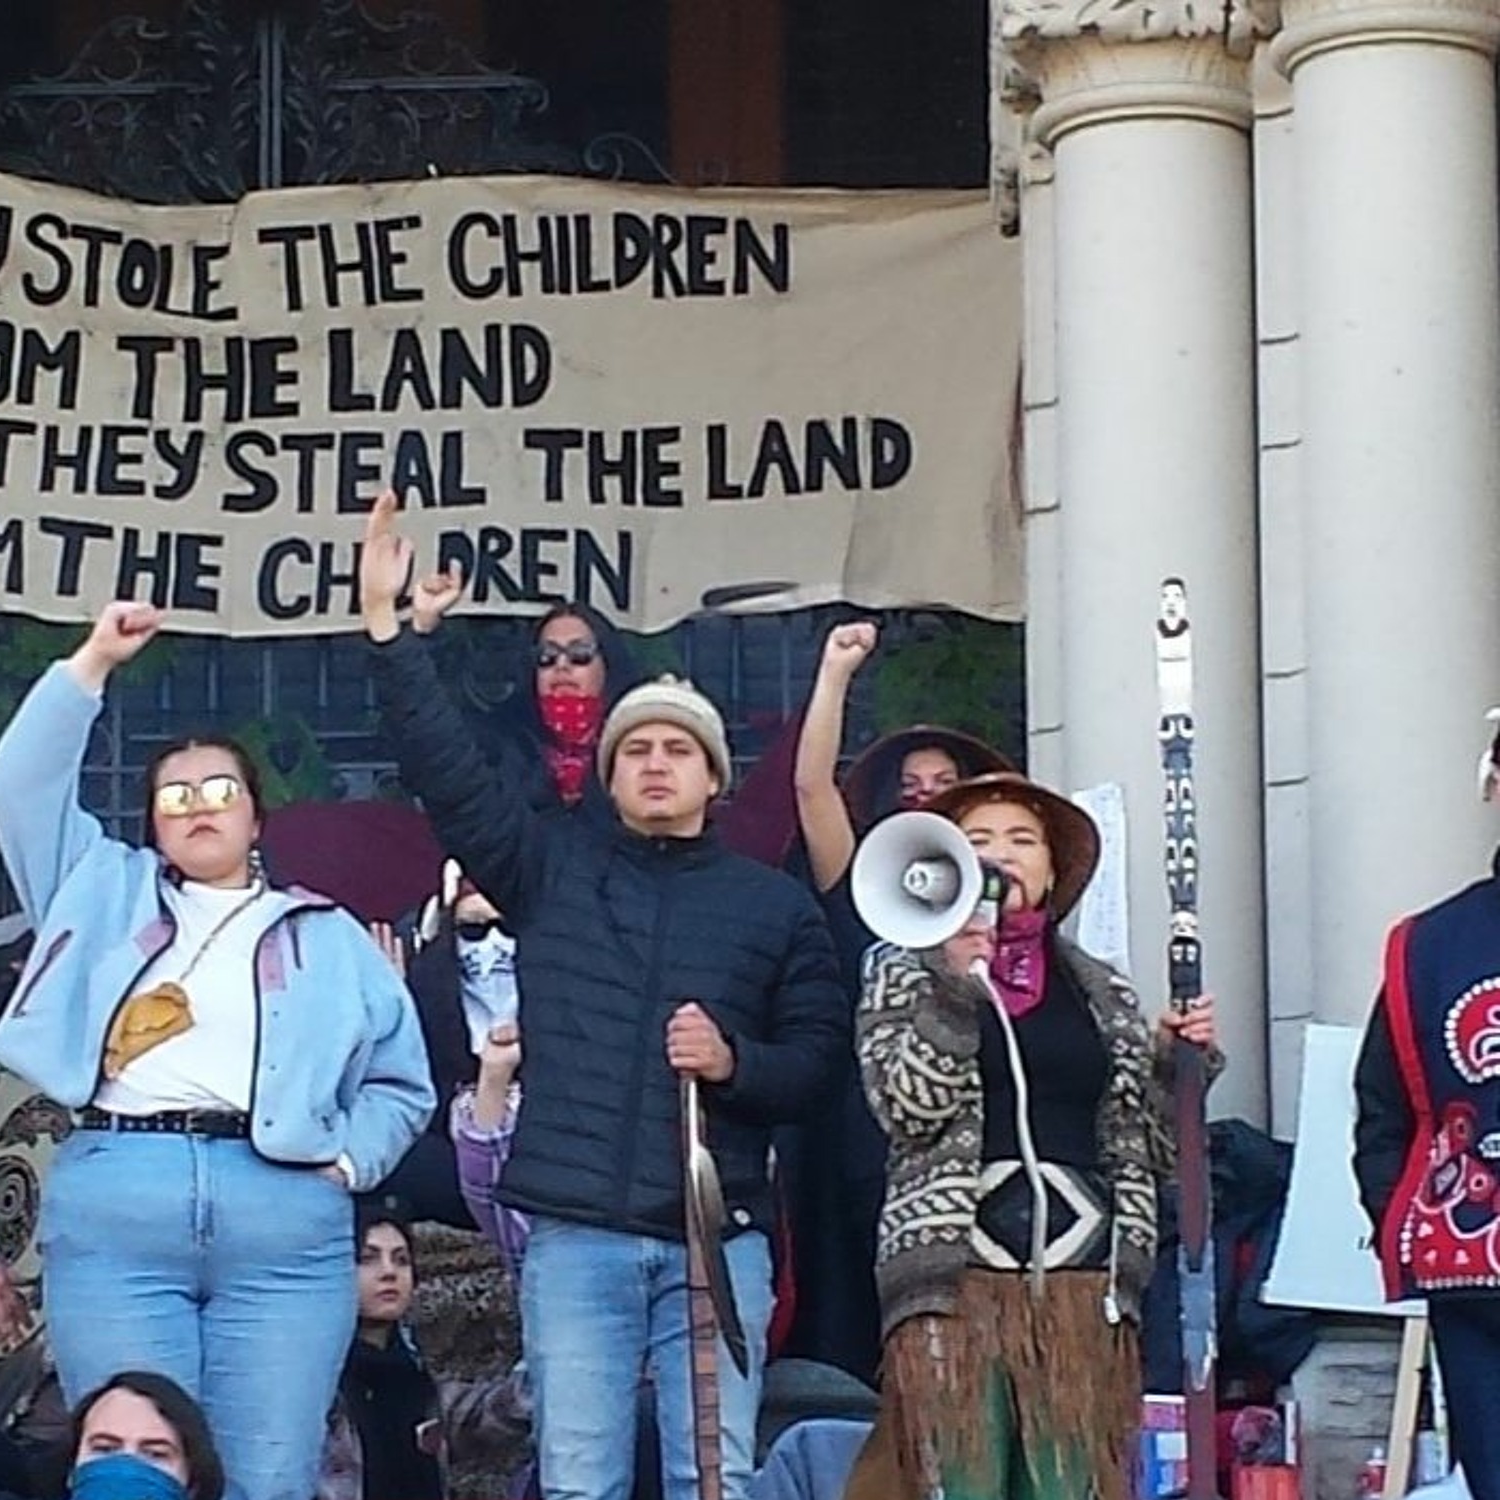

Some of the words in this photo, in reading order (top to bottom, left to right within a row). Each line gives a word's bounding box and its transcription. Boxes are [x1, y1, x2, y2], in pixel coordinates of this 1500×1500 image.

[21, 213, 238, 321] STOLE
[259, 216, 423, 312] THE
[448, 211, 788, 299] CHILDREN
[117, 335, 299, 422] THE
[327, 323, 551, 412] LAND
[220, 428, 487, 514] STEAL
[524, 425, 682, 507] THE
[706, 416, 911, 500] LAND
[39, 515, 223, 613] THE
[258, 526, 632, 619] CHDREN
